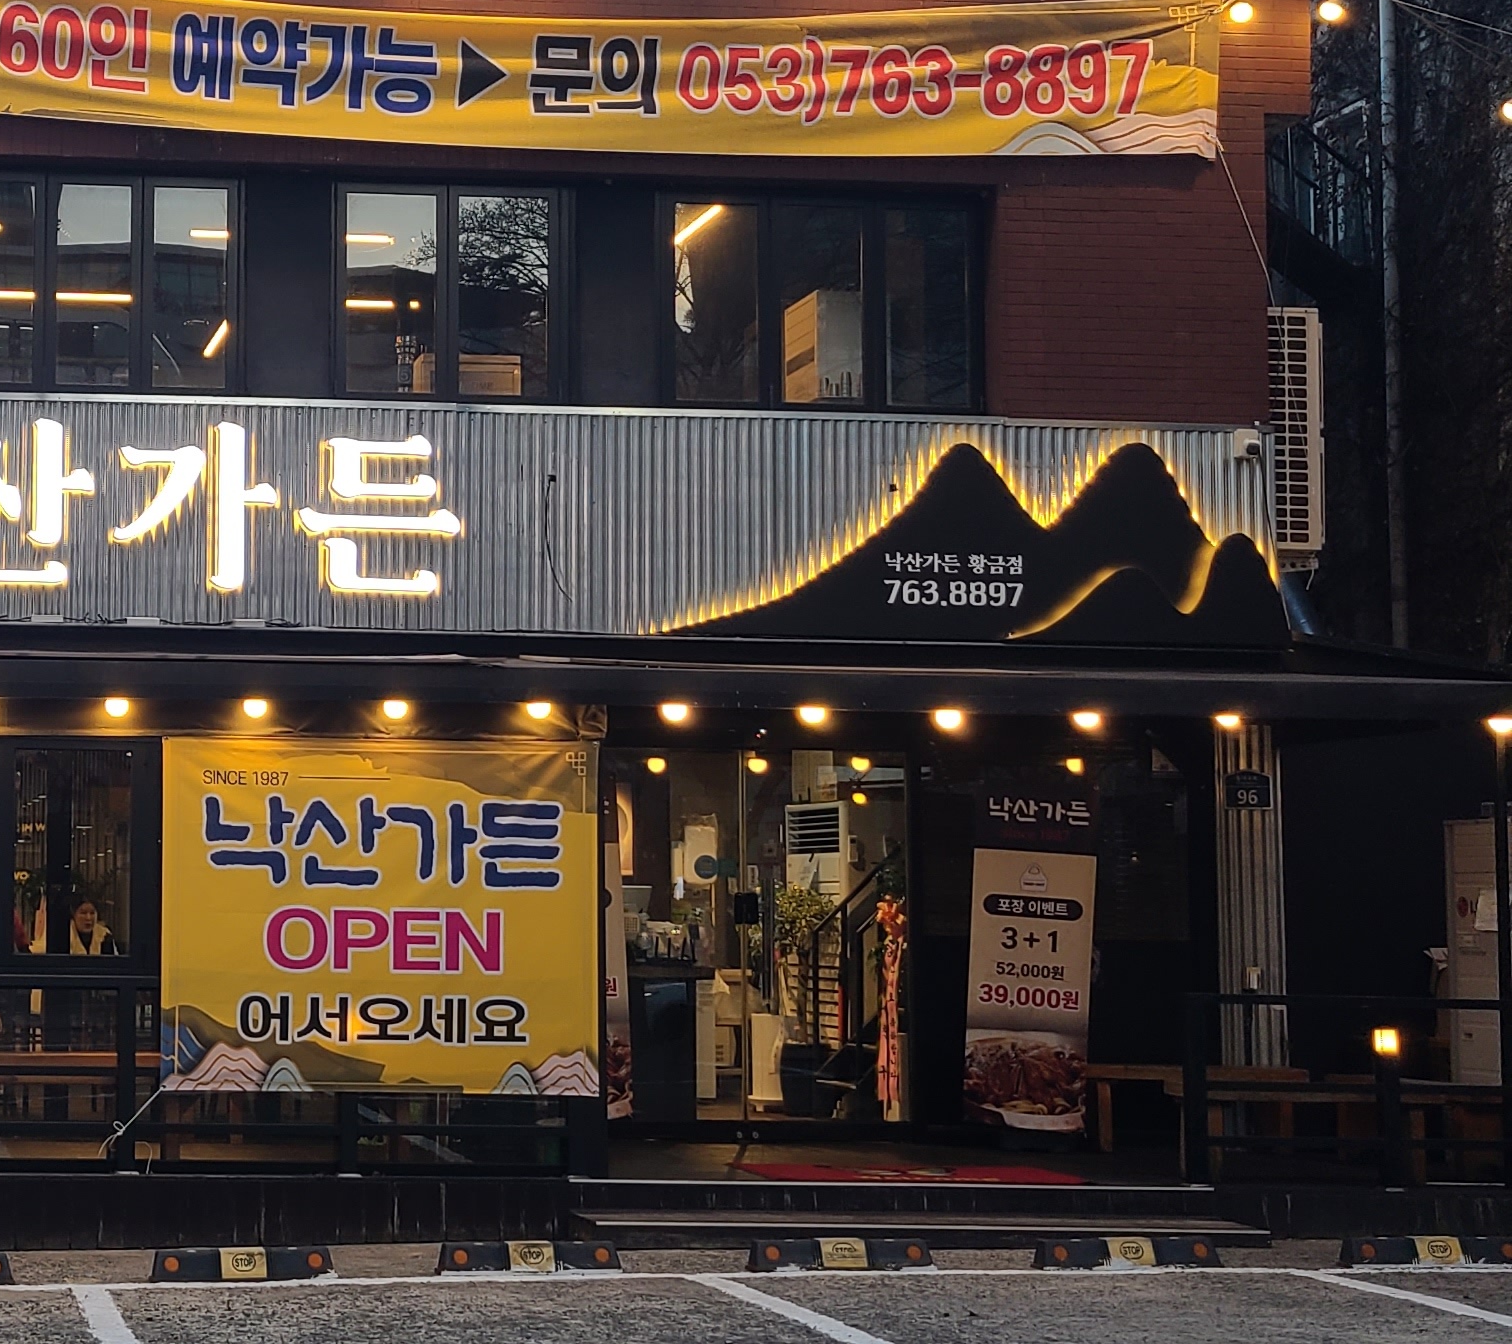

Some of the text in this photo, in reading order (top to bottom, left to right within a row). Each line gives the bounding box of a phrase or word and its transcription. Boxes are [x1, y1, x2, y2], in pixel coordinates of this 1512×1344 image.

[173, 13, 440, 114] 예약가능
[528, 34, 662, 117] 문의
[675, 35, 1154, 126] 053)763-8897
[884, 552, 1024, 575] 낙산가든 황금점
[883, 579, 1024, 607] 763.8897
[202, 770, 289, 787] SINCE 1987
[1236, 789, 1259, 805] 96
[988, 796, 1091, 826] 낙산가든
[202, 794, 564, 890] 낙산가든
[997, 898, 1069, 917] 포장 이벤트
[264, 905, 505, 975] OPEN
[995, 961, 1065, 981] 52,000원
[977, 983, 1080, 1011] 39,000원
[236, 992, 529, 1046] 어서오세요
[1122, 1245, 1140, 1255] STOP
[1430, 1244, 1448, 1255] STOP
[235, 1258, 253, 1267] STOP
